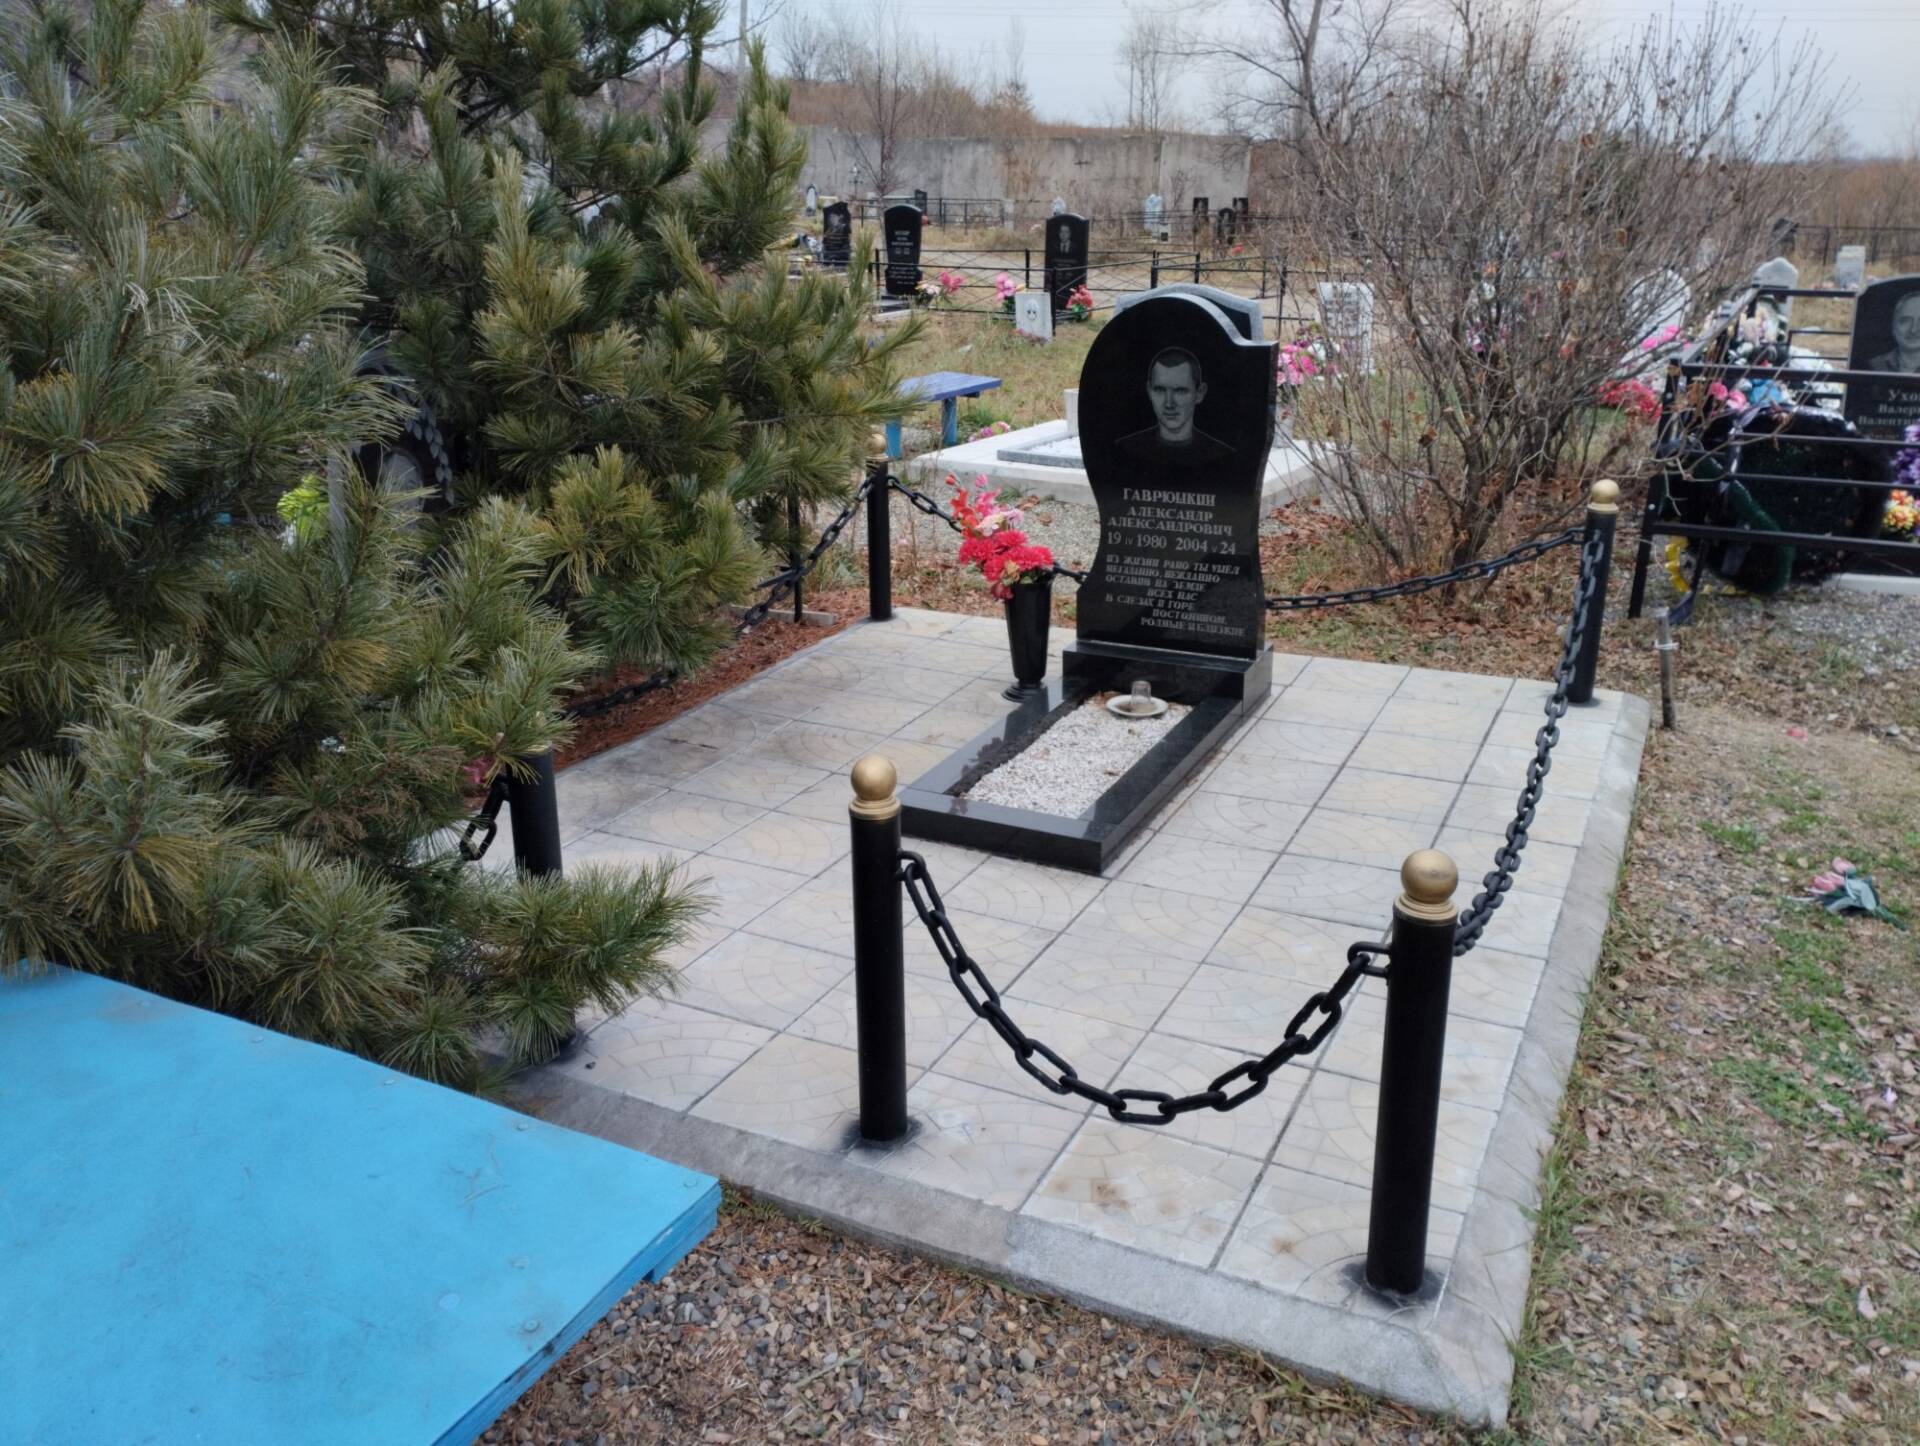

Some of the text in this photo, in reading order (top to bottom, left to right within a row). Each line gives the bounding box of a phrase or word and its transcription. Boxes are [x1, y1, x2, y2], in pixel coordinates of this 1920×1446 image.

[1123, 488, 1216, 506] ГАВРЮШКИН
[1127, 506, 1213, 522] АЛЕКСАНДР
[1107, 517, 1232, 536] АЛЕКСАНДРОВИЧ
[1107, 531, 1121, 545] 19
[1137, 534, 1167, 549] 1980
[1175, 537, 1208, 553] 2004
[1220, 541, 1236, 555] 24
[1106, 554, 1119, 563] ИЗ
[1124, 556, 1159, 567] ЖИЗНИ
[1163, 559, 1190, 570] РАНО
[1194, 562, 1209, 572] ТЫ
[1155, 579, 1168, 588] НА
[1147, 588, 1199, 601] ВСЕХ НАС
